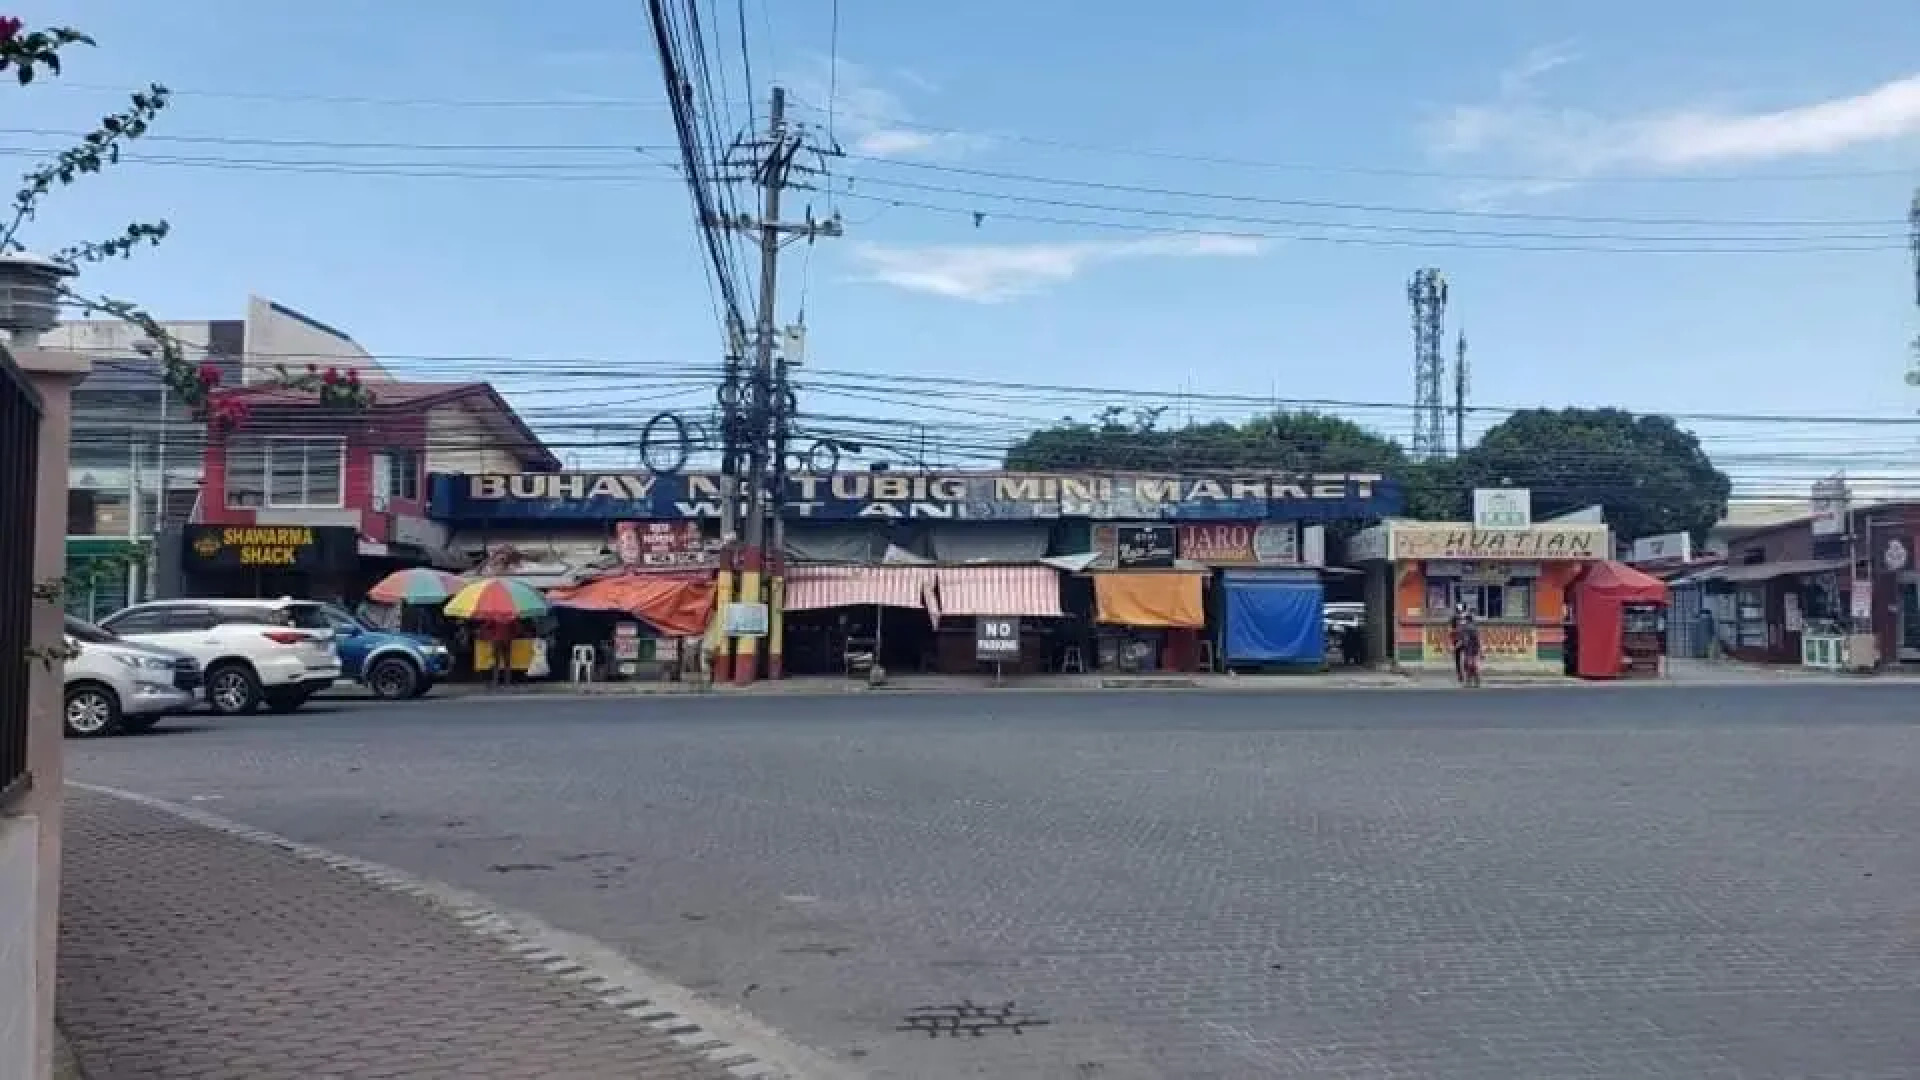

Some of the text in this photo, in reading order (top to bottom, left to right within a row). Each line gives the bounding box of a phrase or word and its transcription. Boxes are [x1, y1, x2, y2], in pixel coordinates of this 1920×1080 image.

[470, 475, 656, 499] BUHAY
[789, 477, 968, 500] TUBIG
[222, 528, 312, 545] SHAWARMA
[1181, 525, 1249, 550] JARO
[1443, 531, 1590, 551] HUATIAN
[239, 546, 297, 565] SHACK
[985, 623, 1011, 637] NO
